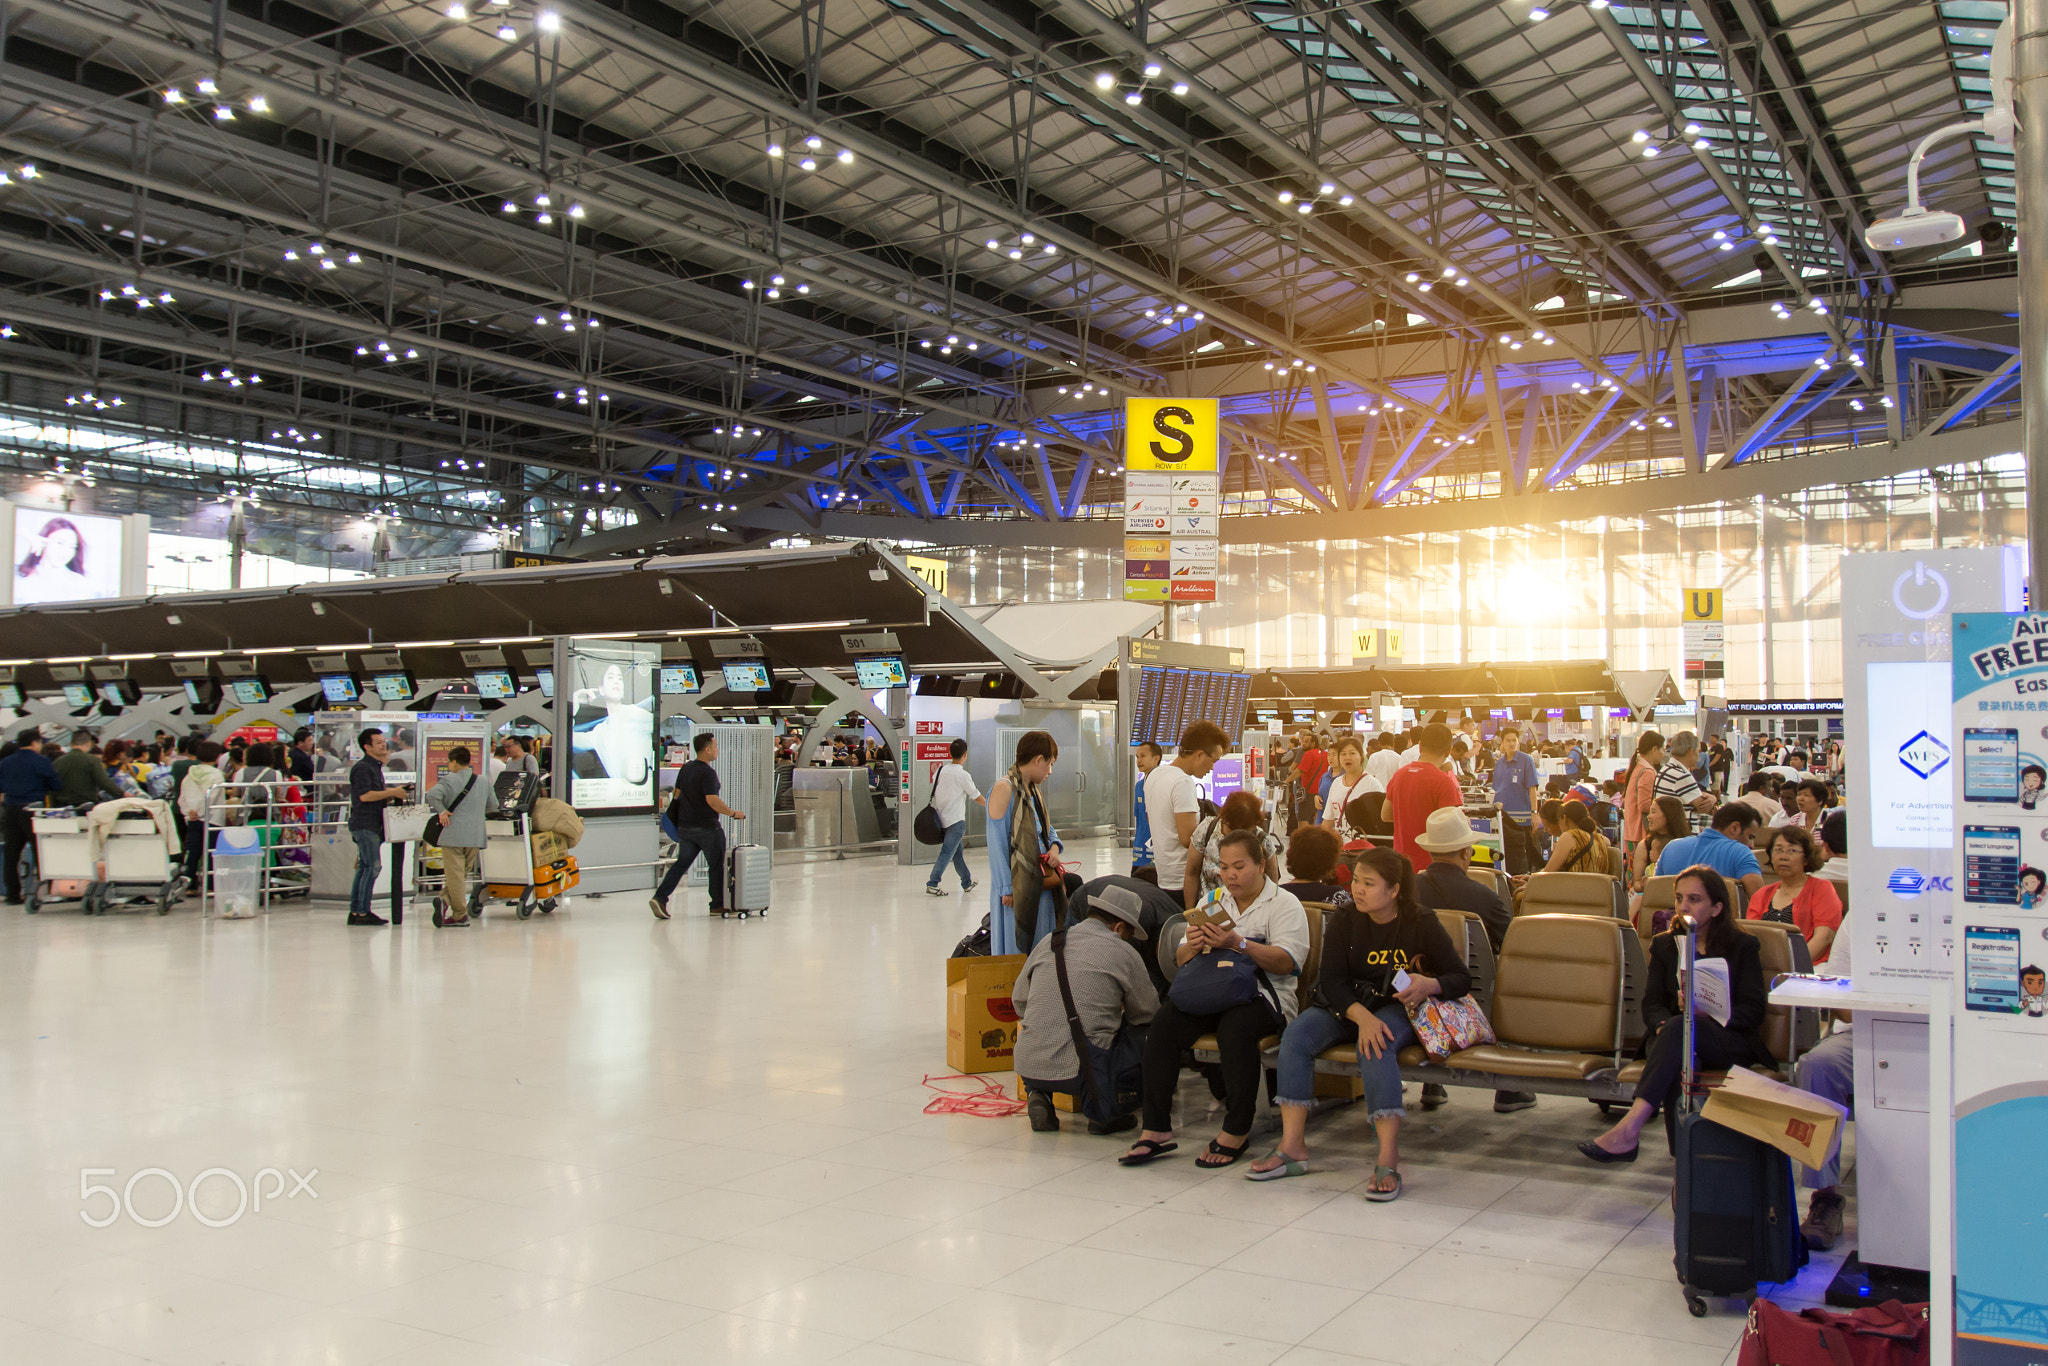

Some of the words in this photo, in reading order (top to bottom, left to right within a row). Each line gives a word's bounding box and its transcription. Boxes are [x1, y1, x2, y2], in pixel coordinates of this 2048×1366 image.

[1149, 406, 1195, 463] S
[1692, 592, 1713, 617] U
[2016, 617, 2048, 637] Air
[740, 642, 758, 652] S02
[846, 638, 865, 648] S01
[1358, 635, 1371, 651] W
[1390, 635, 1399, 651] W
[1856, 631, 1905, 648] FREE
[465, 654, 481, 663] S05
[1973, 638, 2048, 677] FREE
[2014, 679, 2048, 695] Eas
[1907, 751, 1940, 761] WPS
[1978, 746, 2003, 754] Select
[1890, 801, 1905, 809] For
[1971, 942, 2014, 952] Registration
